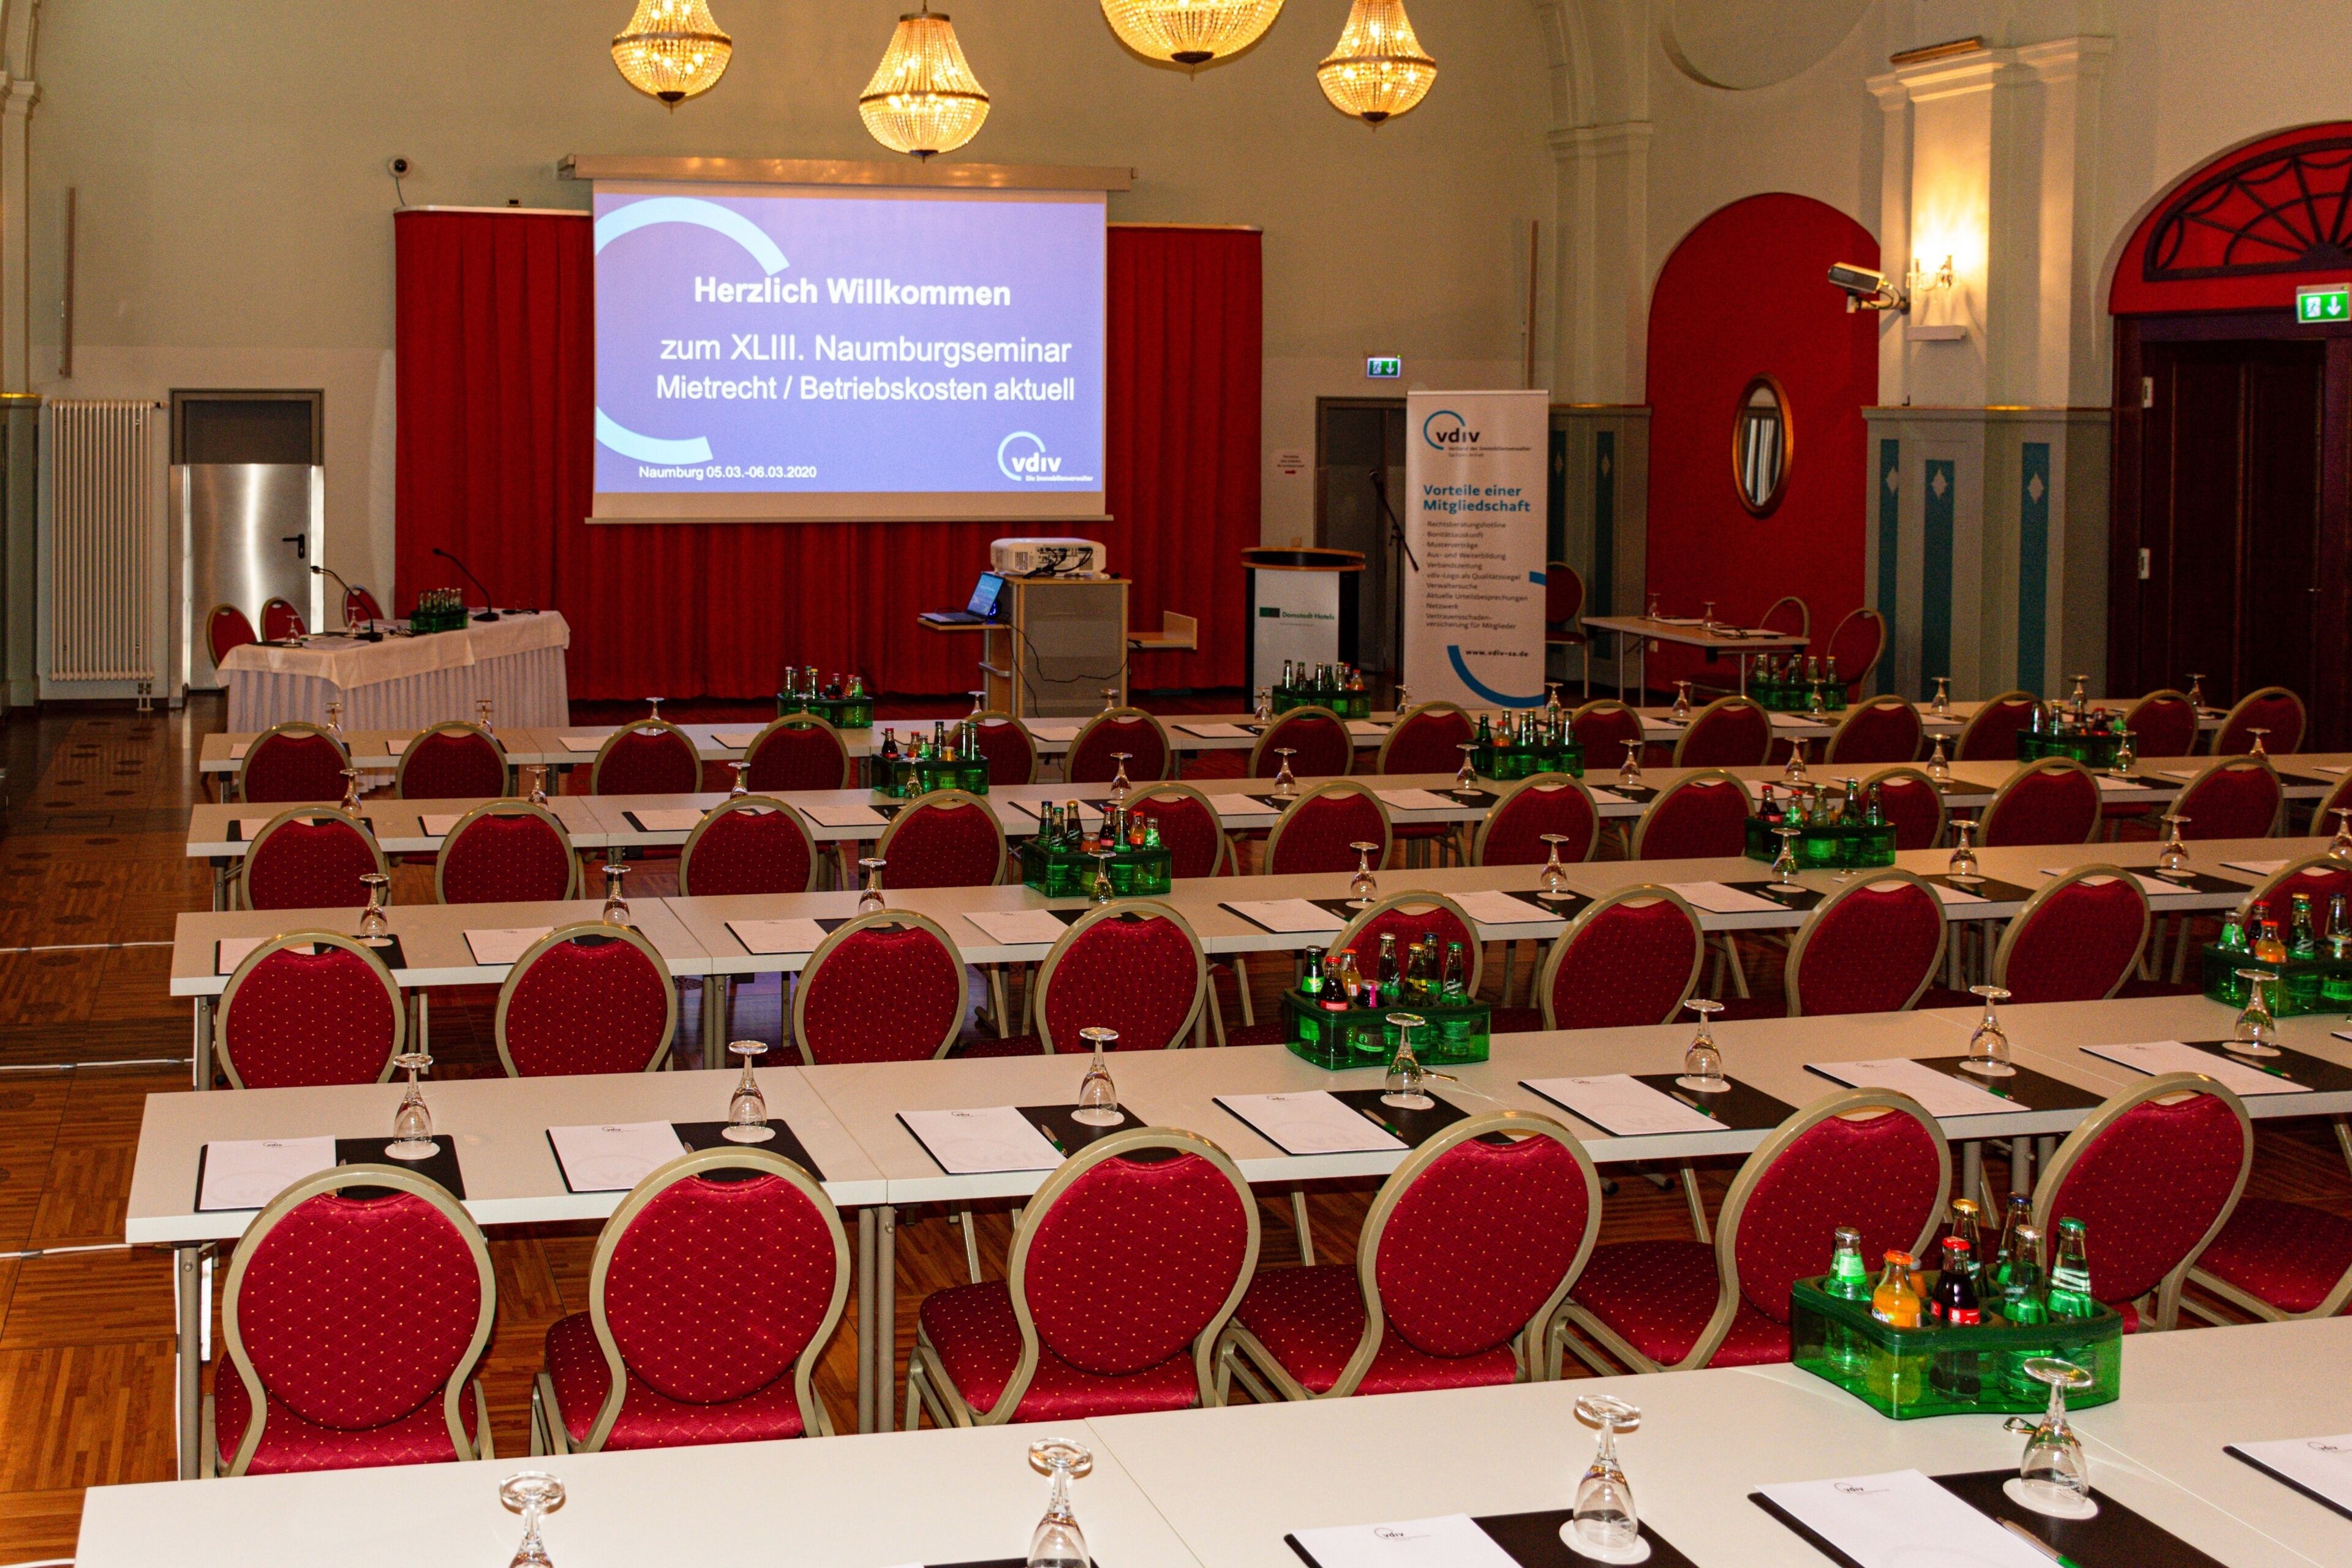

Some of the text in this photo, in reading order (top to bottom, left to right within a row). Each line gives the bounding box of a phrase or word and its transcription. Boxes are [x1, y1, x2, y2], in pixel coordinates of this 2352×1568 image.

[695, 276, 1011, 306] Herzlich Willkommen
[660, 334, 1071, 368] zum XLIII. Naumburgseminar
[656, 375, 1074, 401] Mietrecht / Betriebskosten aktuell
[1436, 428, 1480, 443] vdiv
[1011, 451, 1062, 472] vdiv
[638, 466, 817, 481] Naumburg 05.03.-06.03.2020
[1423, 484, 1521, 496] Vorteile einer
[1423, 500, 1531, 514] Mitgliedschaft
[1427, 521, 1506, 529] Rechtsberatungshotline
[1427, 541, 1478, 550] Musterverträge
[1465, 649, 1529, 657] www.vdiv-sa.de
